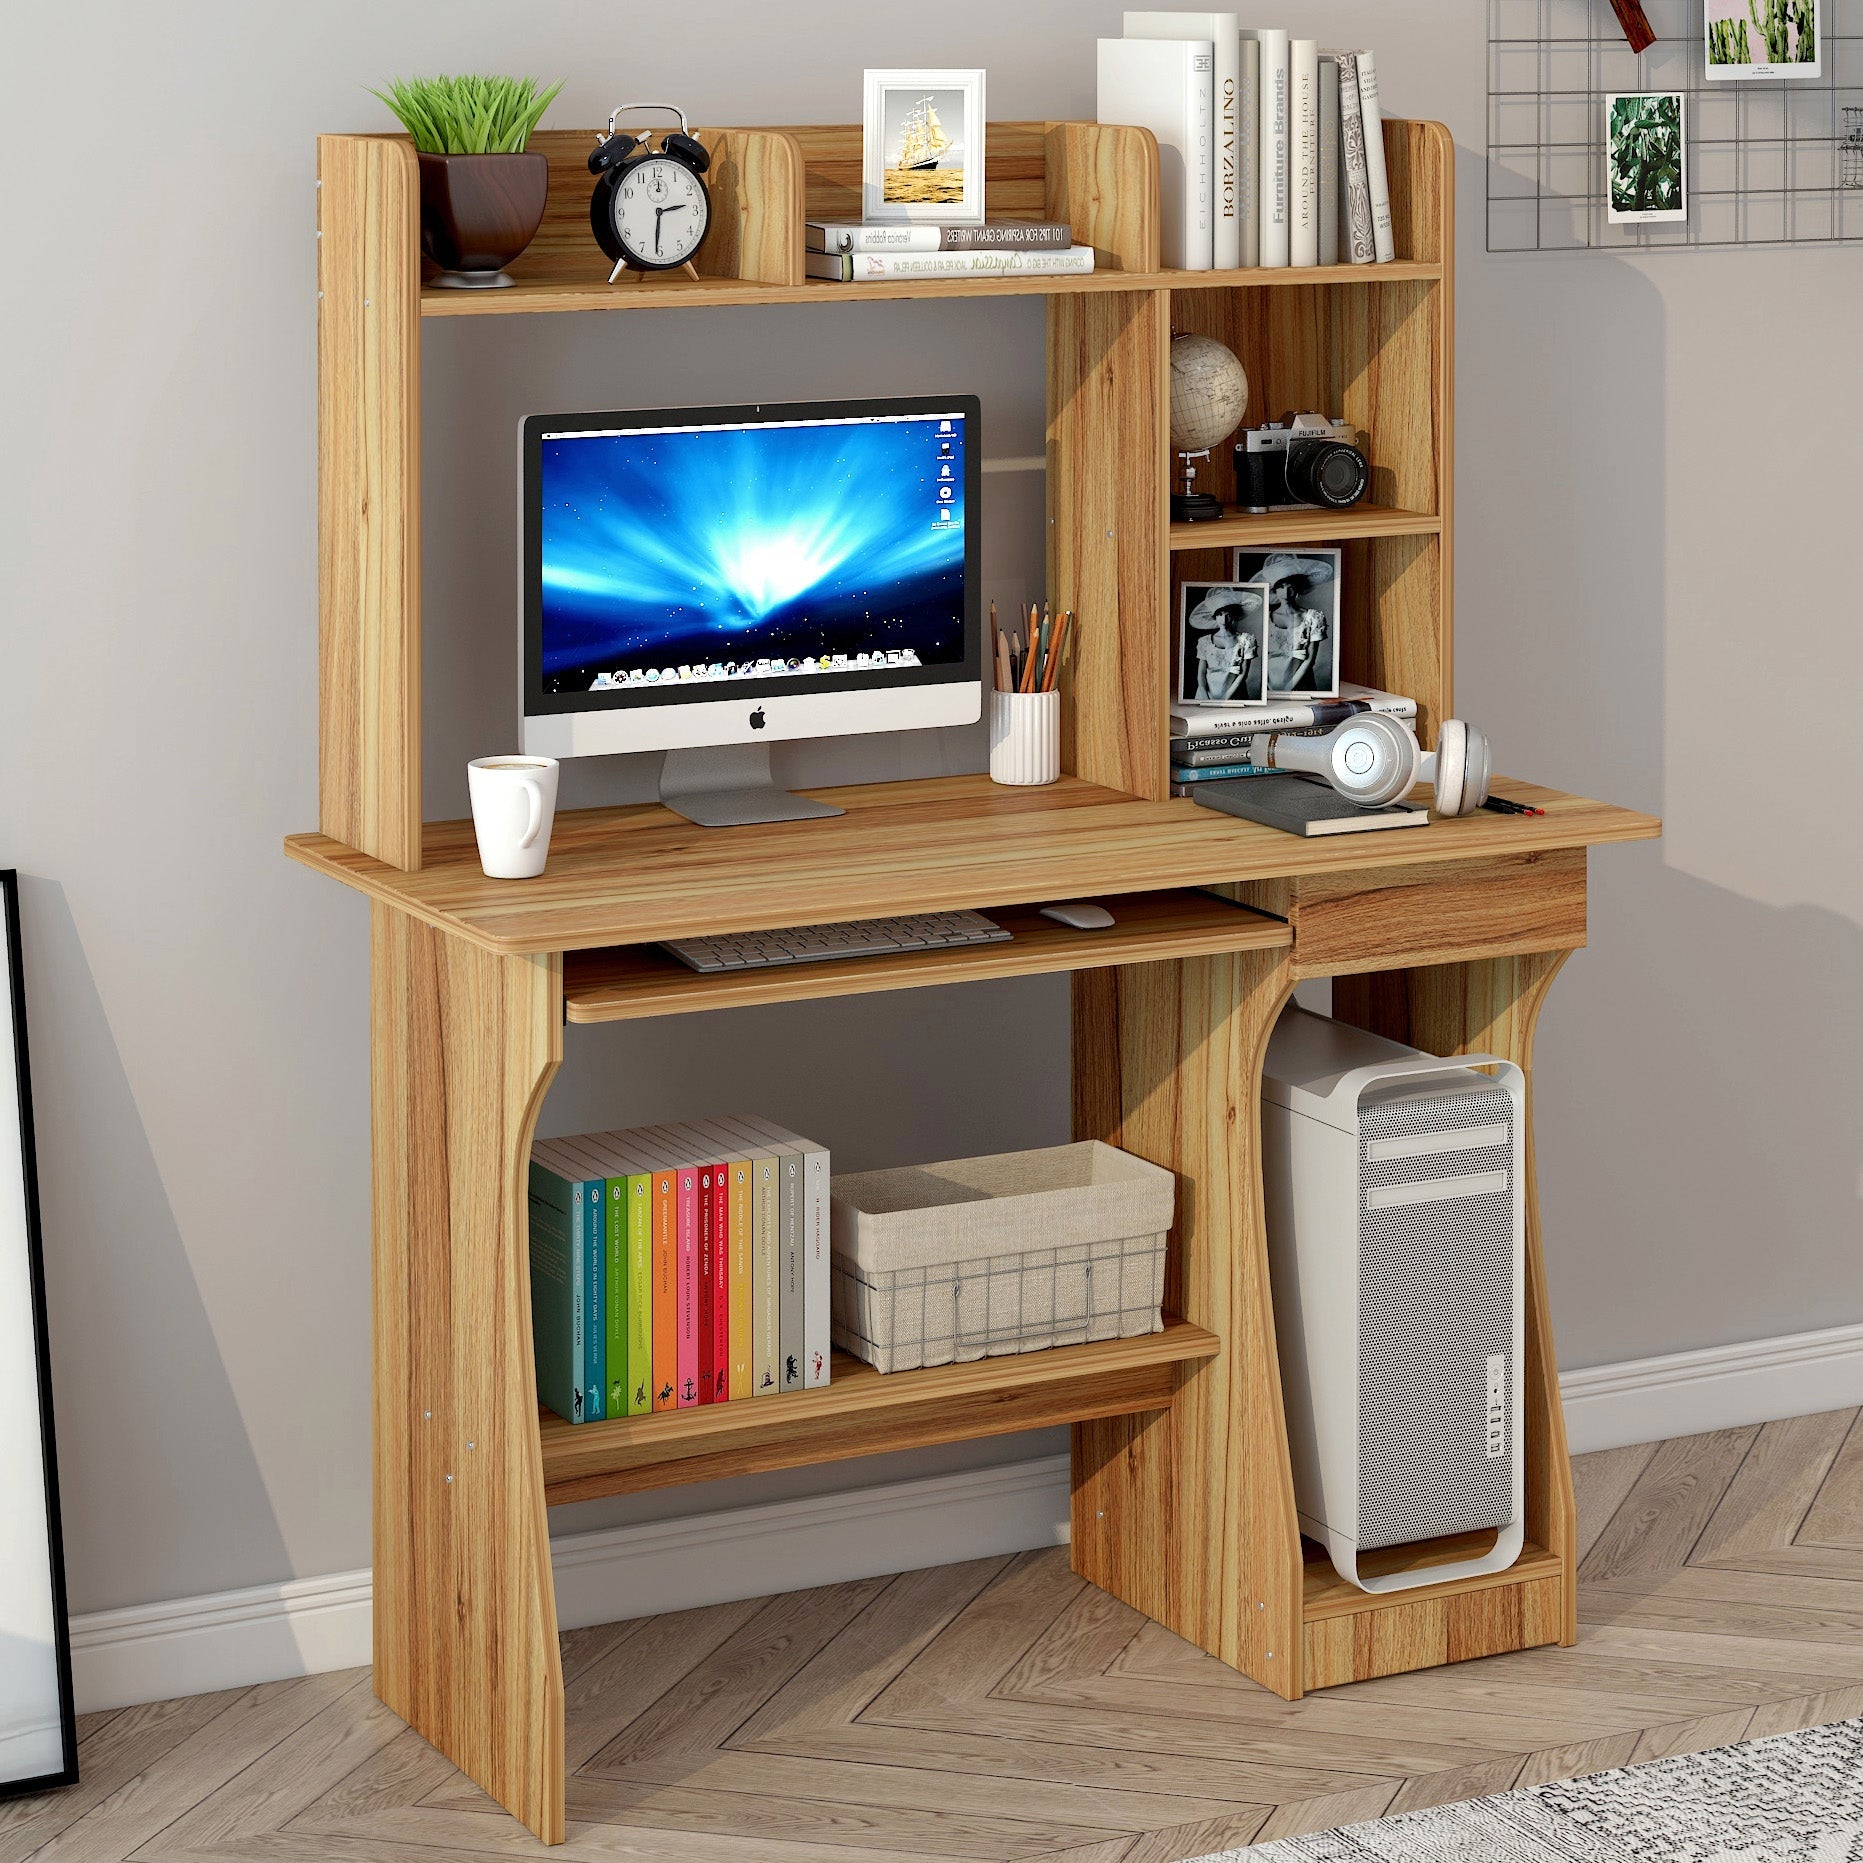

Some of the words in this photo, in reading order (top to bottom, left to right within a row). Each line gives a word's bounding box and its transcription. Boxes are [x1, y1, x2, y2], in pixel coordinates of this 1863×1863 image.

[1272, 68, 1285, 135] Brands
[1301, 73, 1310, 123] HOUSE
[1223, 78, 1235, 219] BORZALINO
[1301, 130, 1310, 160] THE
[1199, 88, 1207, 230] EICHHOLTZ
[637, 172, 645, 184] 11
[652, 167, 663, 178] 12
[673, 171, 677, 182] 1
[1272, 140, 1285, 224] Furniture
[624, 188, 634, 200] 10
[685, 185, 693, 196] 2
[1301, 166, 1310, 229] AROUND
[618, 208, 625, 220] 9
[692, 205, 699, 217] 3
[624, 228, 631, 239] 8
[686, 225, 693, 236] 4
[639, 242, 646, 253] 7
[656, 245, 664, 257] 6
[676, 240, 683, 251] 5
[789, 1208, 795, 1216] OF
[637, 1228, 643, 1236] OF
[738, 1229, 744, 1237] OF
[703, 1242, 709, 1251] OF
[766, 1287, 772, 1295] OF
